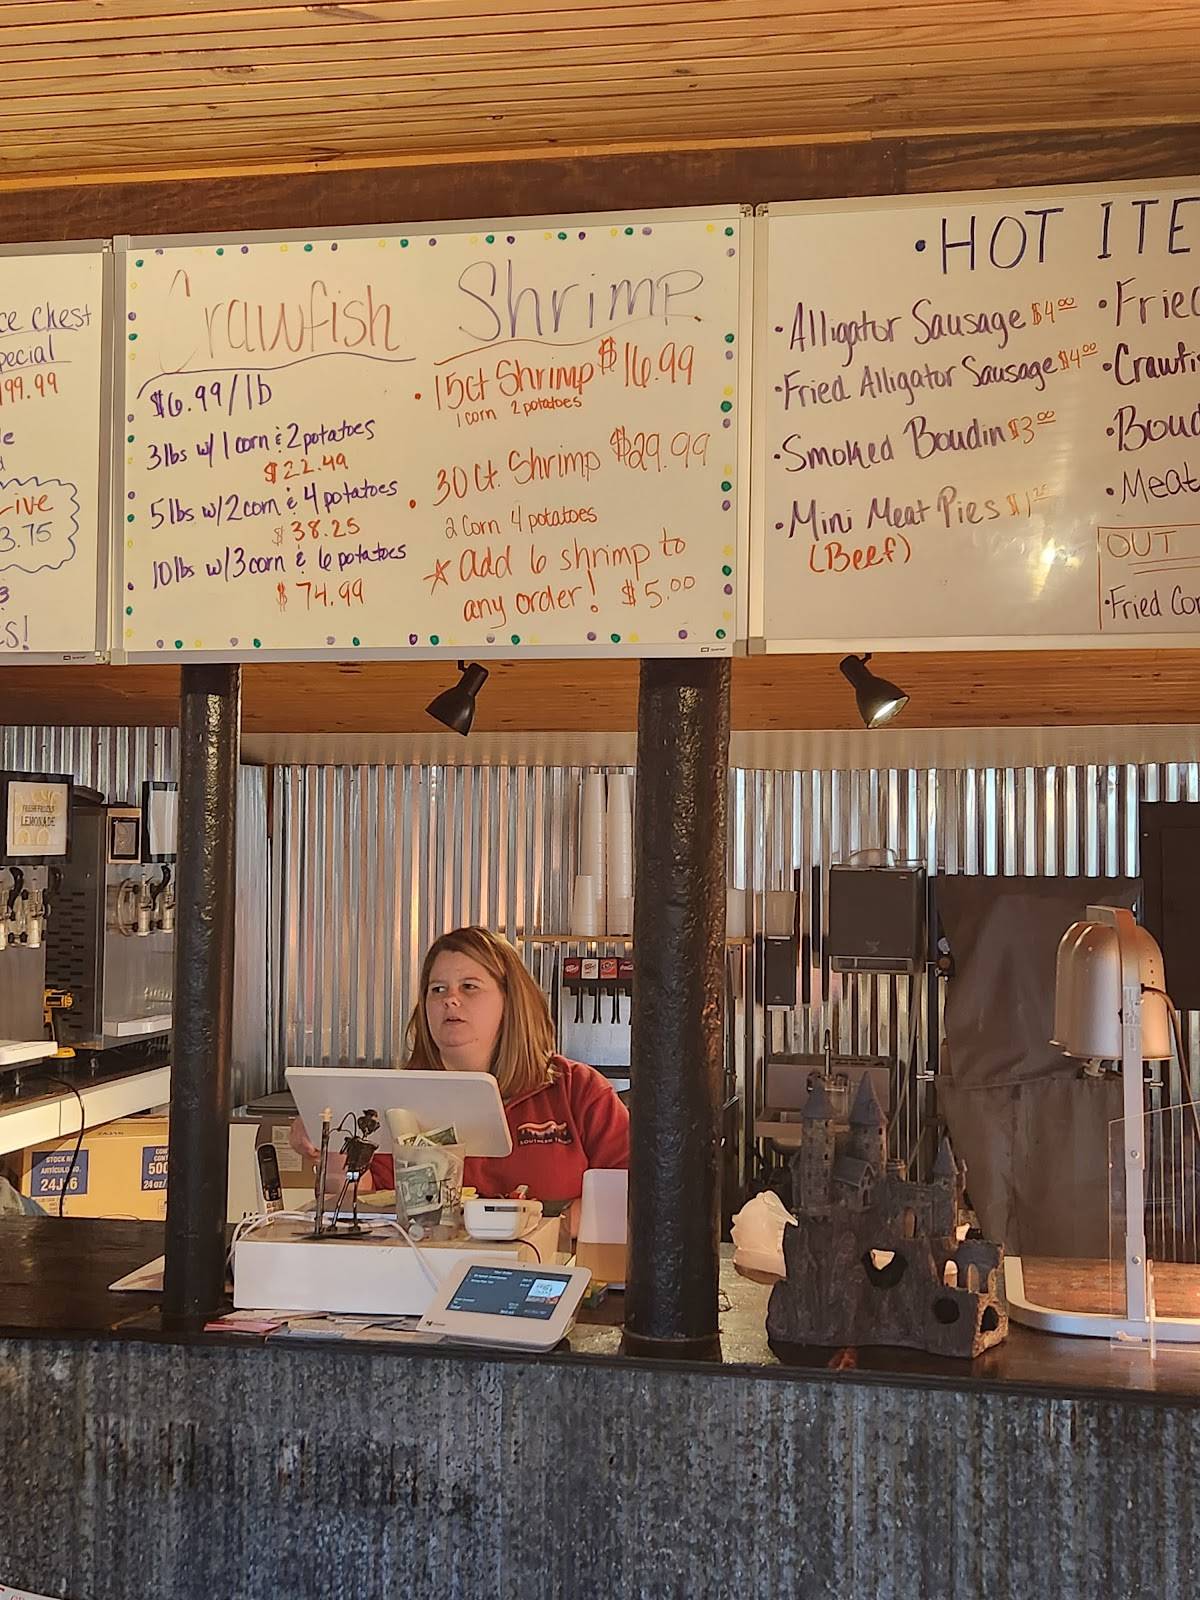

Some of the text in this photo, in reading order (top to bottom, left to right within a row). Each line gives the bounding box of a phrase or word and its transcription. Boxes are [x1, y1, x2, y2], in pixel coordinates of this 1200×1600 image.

[941, 207, 1064, 275] HOT
[32, 301, 92, 332] Chest
[458, 258, 704, 342] Shrimp
[789, 301, 902, 368] Alligator
[912, 298, 1026, 349] Sausage
[496, 357, 595, 397] Shrimp
[598, 336, 695, 389] $16.99
[784, 370, 851, 411] Fried
[860, 363, 957, 406] Alligator
[961, 354, 1060, 391] Sausage
[150, 373, 272, 418] $6.99/lb
[523, 396, 582, 416] potatoes
[508, 445, 601, 485] Shrimp
[609, 425, 711, 472] $29.99
[782, 434, 895, 473] Smoked
[904, 415, 1006, 459] Boudin
[263, 452, 348, 484] $22.49
[1121, 461, 1200, 504] Meat
[323, 479, 399, 514] potatoes
[788, 500, 853, 541] Mini
[867, 497, 930, 530] Meat
[936, 485, 1001, 528] Pies
[528, 506, 598, 533] potatoes
[338, 542, 407, 567] potatoes
[530, 545, 546, 574] 6
[560, 537, 651, 582] shrimp
[658, 527, 686, 557] to
[809, 533, 912, 573] (Beef)
[1107, 530, 1177, 558] OUT
[463, 595, 507, 629] any
[1110, 584, 1162, 620] Fried
[21, 815, 55, 827] LEMONADE
[40, 1177, 78, 1192] 24J6
